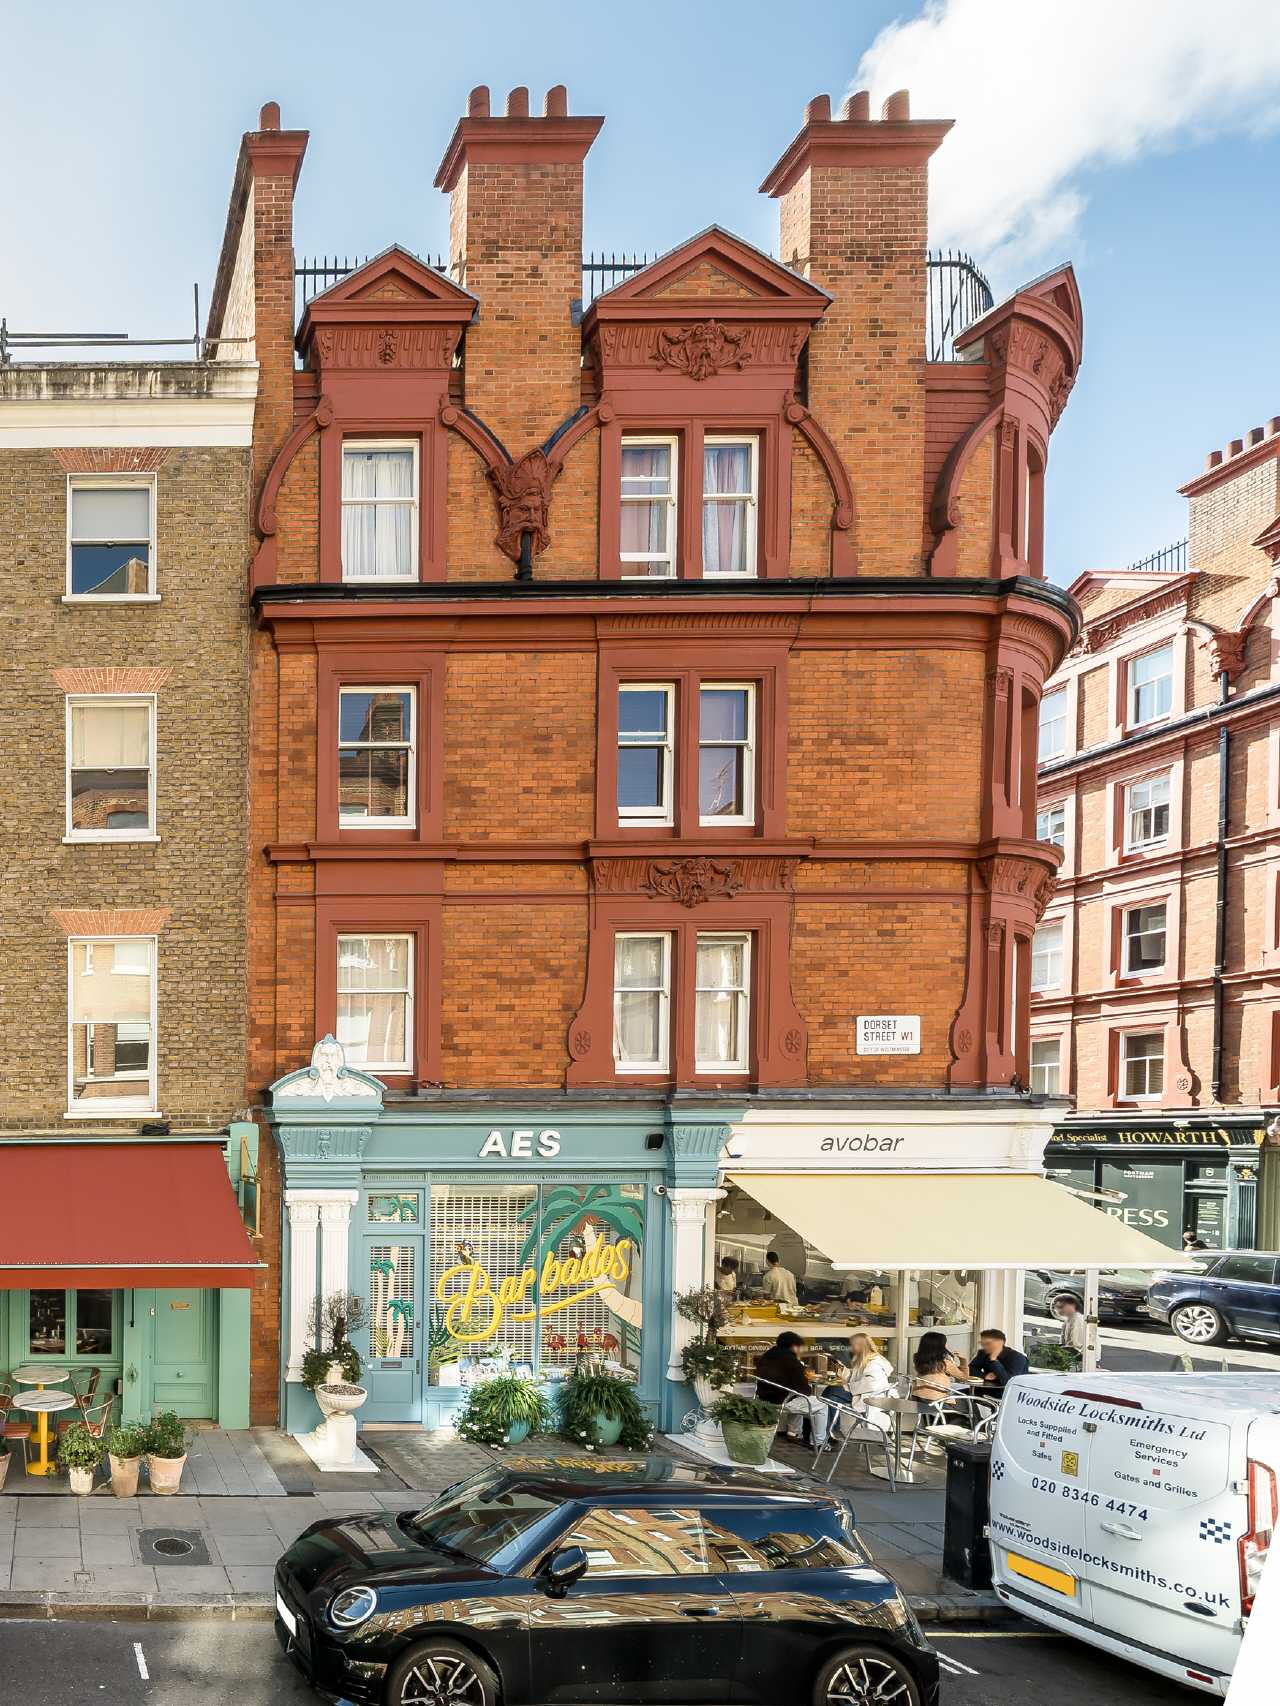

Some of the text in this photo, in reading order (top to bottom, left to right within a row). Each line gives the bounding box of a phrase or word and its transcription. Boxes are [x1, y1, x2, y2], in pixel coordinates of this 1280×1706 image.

[864, 1020, 897, 1030] DORSET
[864, 1032, 913, 1041] STREET W1
[479, 1130, 561, 1157] AES
[820, 1134, 905, 1152] avobar
[1067, 1133, 1107, 1142] Specialist
[1118, 1132, 1217, 1143] HOWARTH
[1106, 1207, 1169, 1227] RESS
[436, 1231, 631, 1343] Barbados
[1016, 1391, 1208, 1441] Woodside Locksmiths Ltd
[1017, 1416, 1038, 1427] Locks
[1026, 1428, 1063, 1443] and Fitted
[1032, 1449, 1053, 1461] Safes
[1129, 1439, 1188, 1460] Emergency
[1134, 1450, 1179, 1468] Services
[1114, 1470, 1199, 1498] Gates and Grilles
[1031, 1477, 1148, 1521] 020 8346 4474
[992, 1519, 1231, 1609] www.woodsidelocksmiths.co.uk
